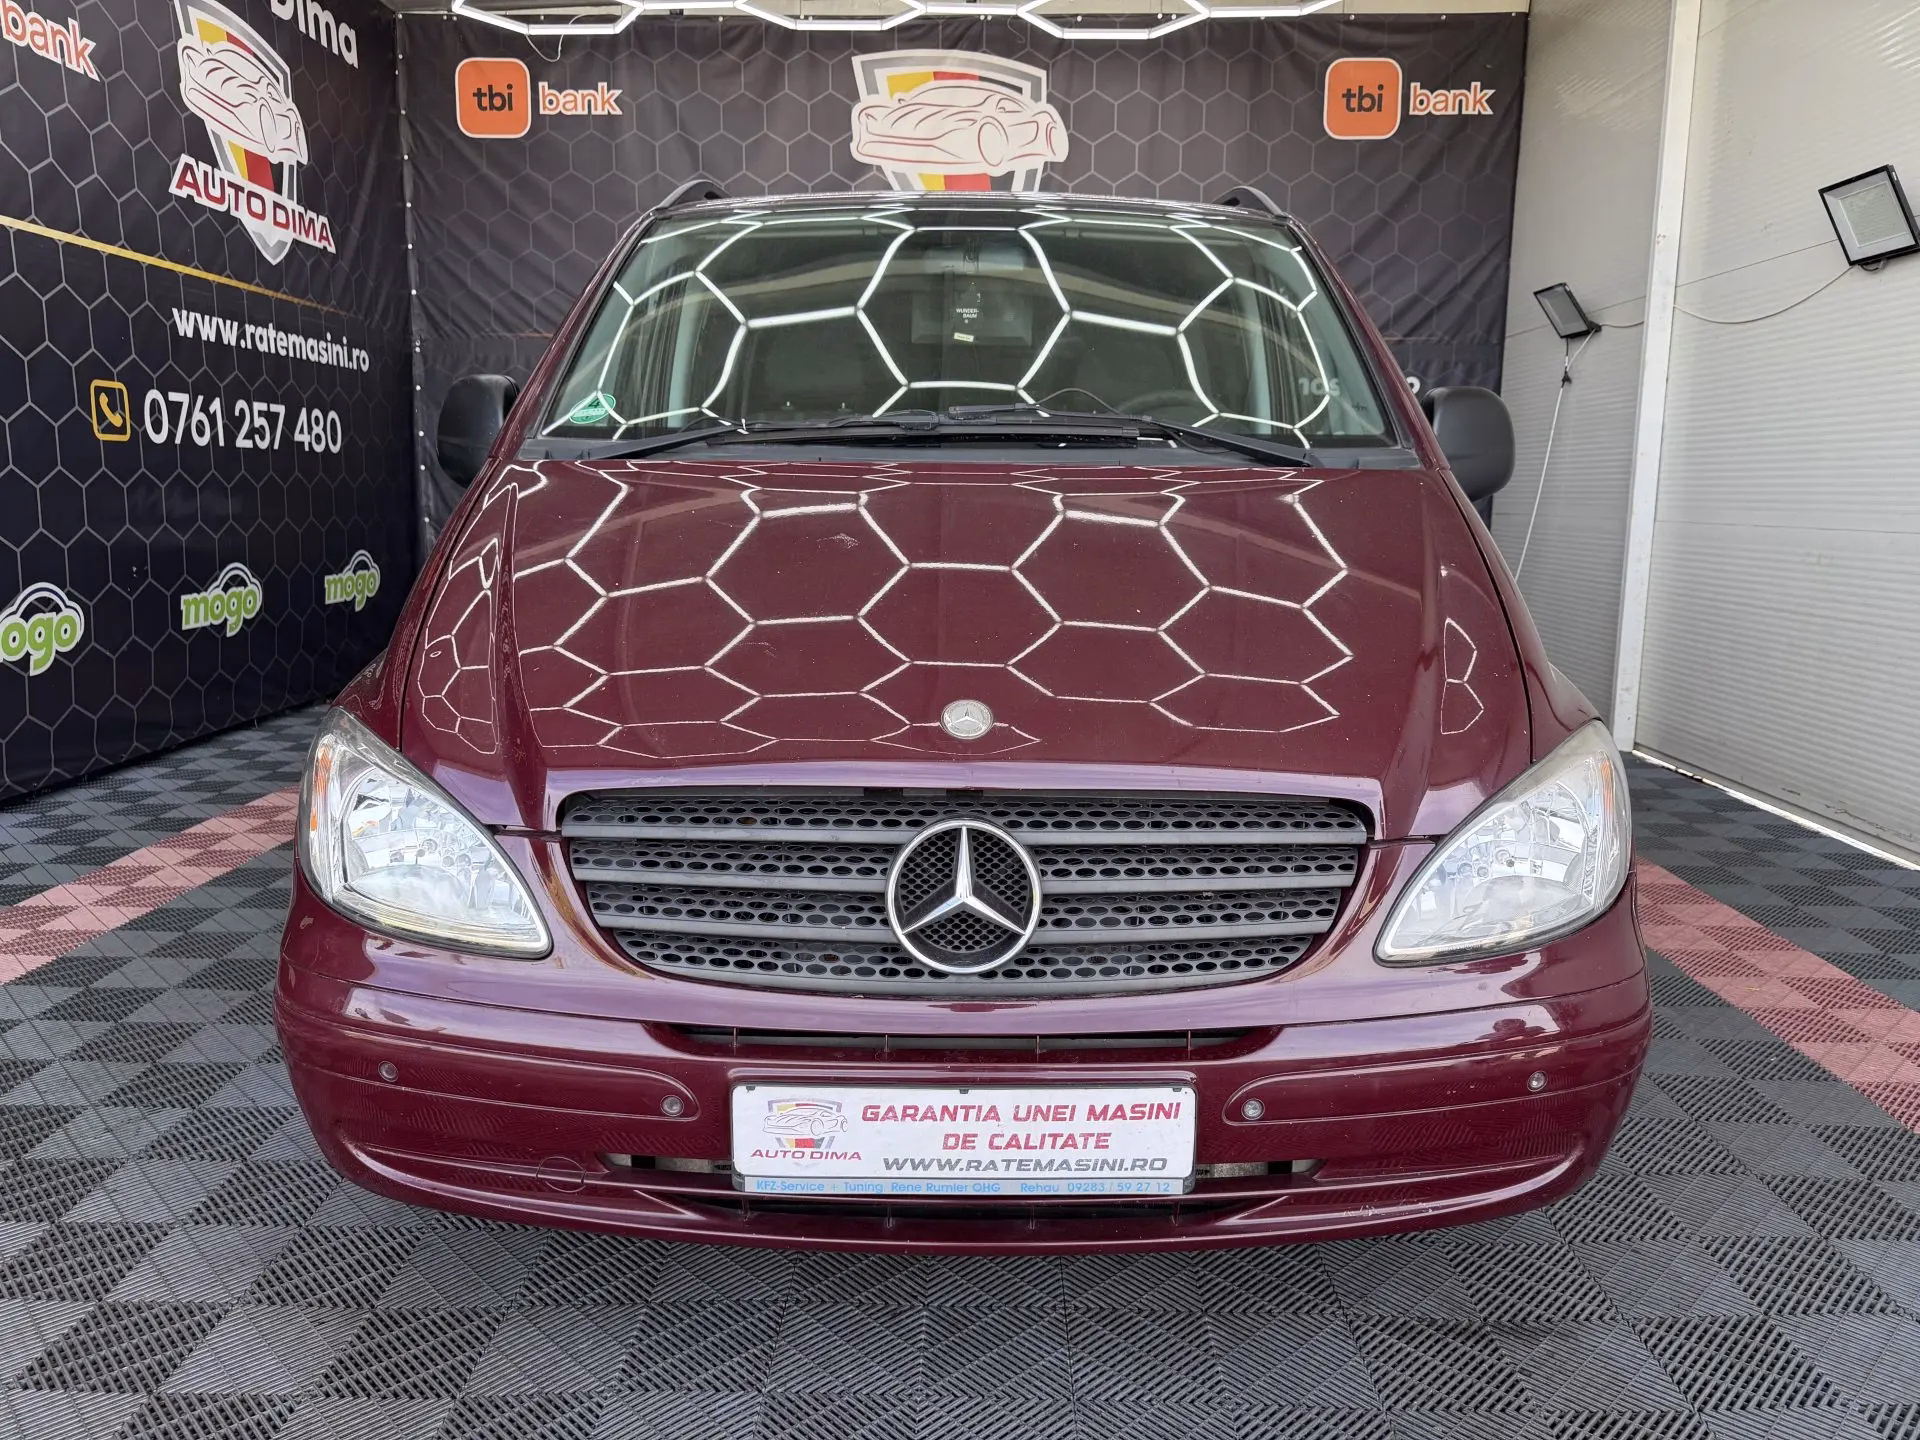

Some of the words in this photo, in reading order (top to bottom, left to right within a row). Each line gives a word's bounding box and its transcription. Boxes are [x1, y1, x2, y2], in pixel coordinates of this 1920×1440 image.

[1, 0, 97, 79] bank
[472, 83, 514, 112] tbi
[540, 84, 619, 113] bank
[1341, 84, 1385, 113] tbi
[1411, 84, 1492, 114] bank
[175, 161, 267, 222] AUTO
[272, 199, 334, 249] DIMA
[171, 307, 371, 373] www.ratemasini.ro
[143, 388, 225, 448] 0761
[234, 398, 286, 450] 257
[293, 406, 342, 454] 480
[326, 568, 380, 610] mogo
[182, 585, 260, 636] mogo
[0, 614, 79, 672] ogo
[861, 1104, 1001, 1122] GARANTIA
[1012, 1104, 1076, 1122] UNEI
[1086, 1102, 1181, 1122] MASINI
[751, 1149, 805, 1159] AUTO
[809, 1150, 862, 1161] DIMA
[942, 1133, 978, 1150] DE
[988, 1132, 1112, 1150] CALITATE
[883, 1157, 1168, 1172] WWW.RATEMASINI.RO
[757, 1180, 825, 1191] KFZ-Service
[843, 1181, 884, 1194] Tuning
[891, 1182, 922, 1192] Rene
[1020, 1182, 1060, 1193] Rehau
[1067, 1182, 1105, 1193] 09283
[1117, 1182, 1132, 1192] 59
[1136, 1182, 1151, 1192] 27
[1156, 1182, 1170, 1192] 12
